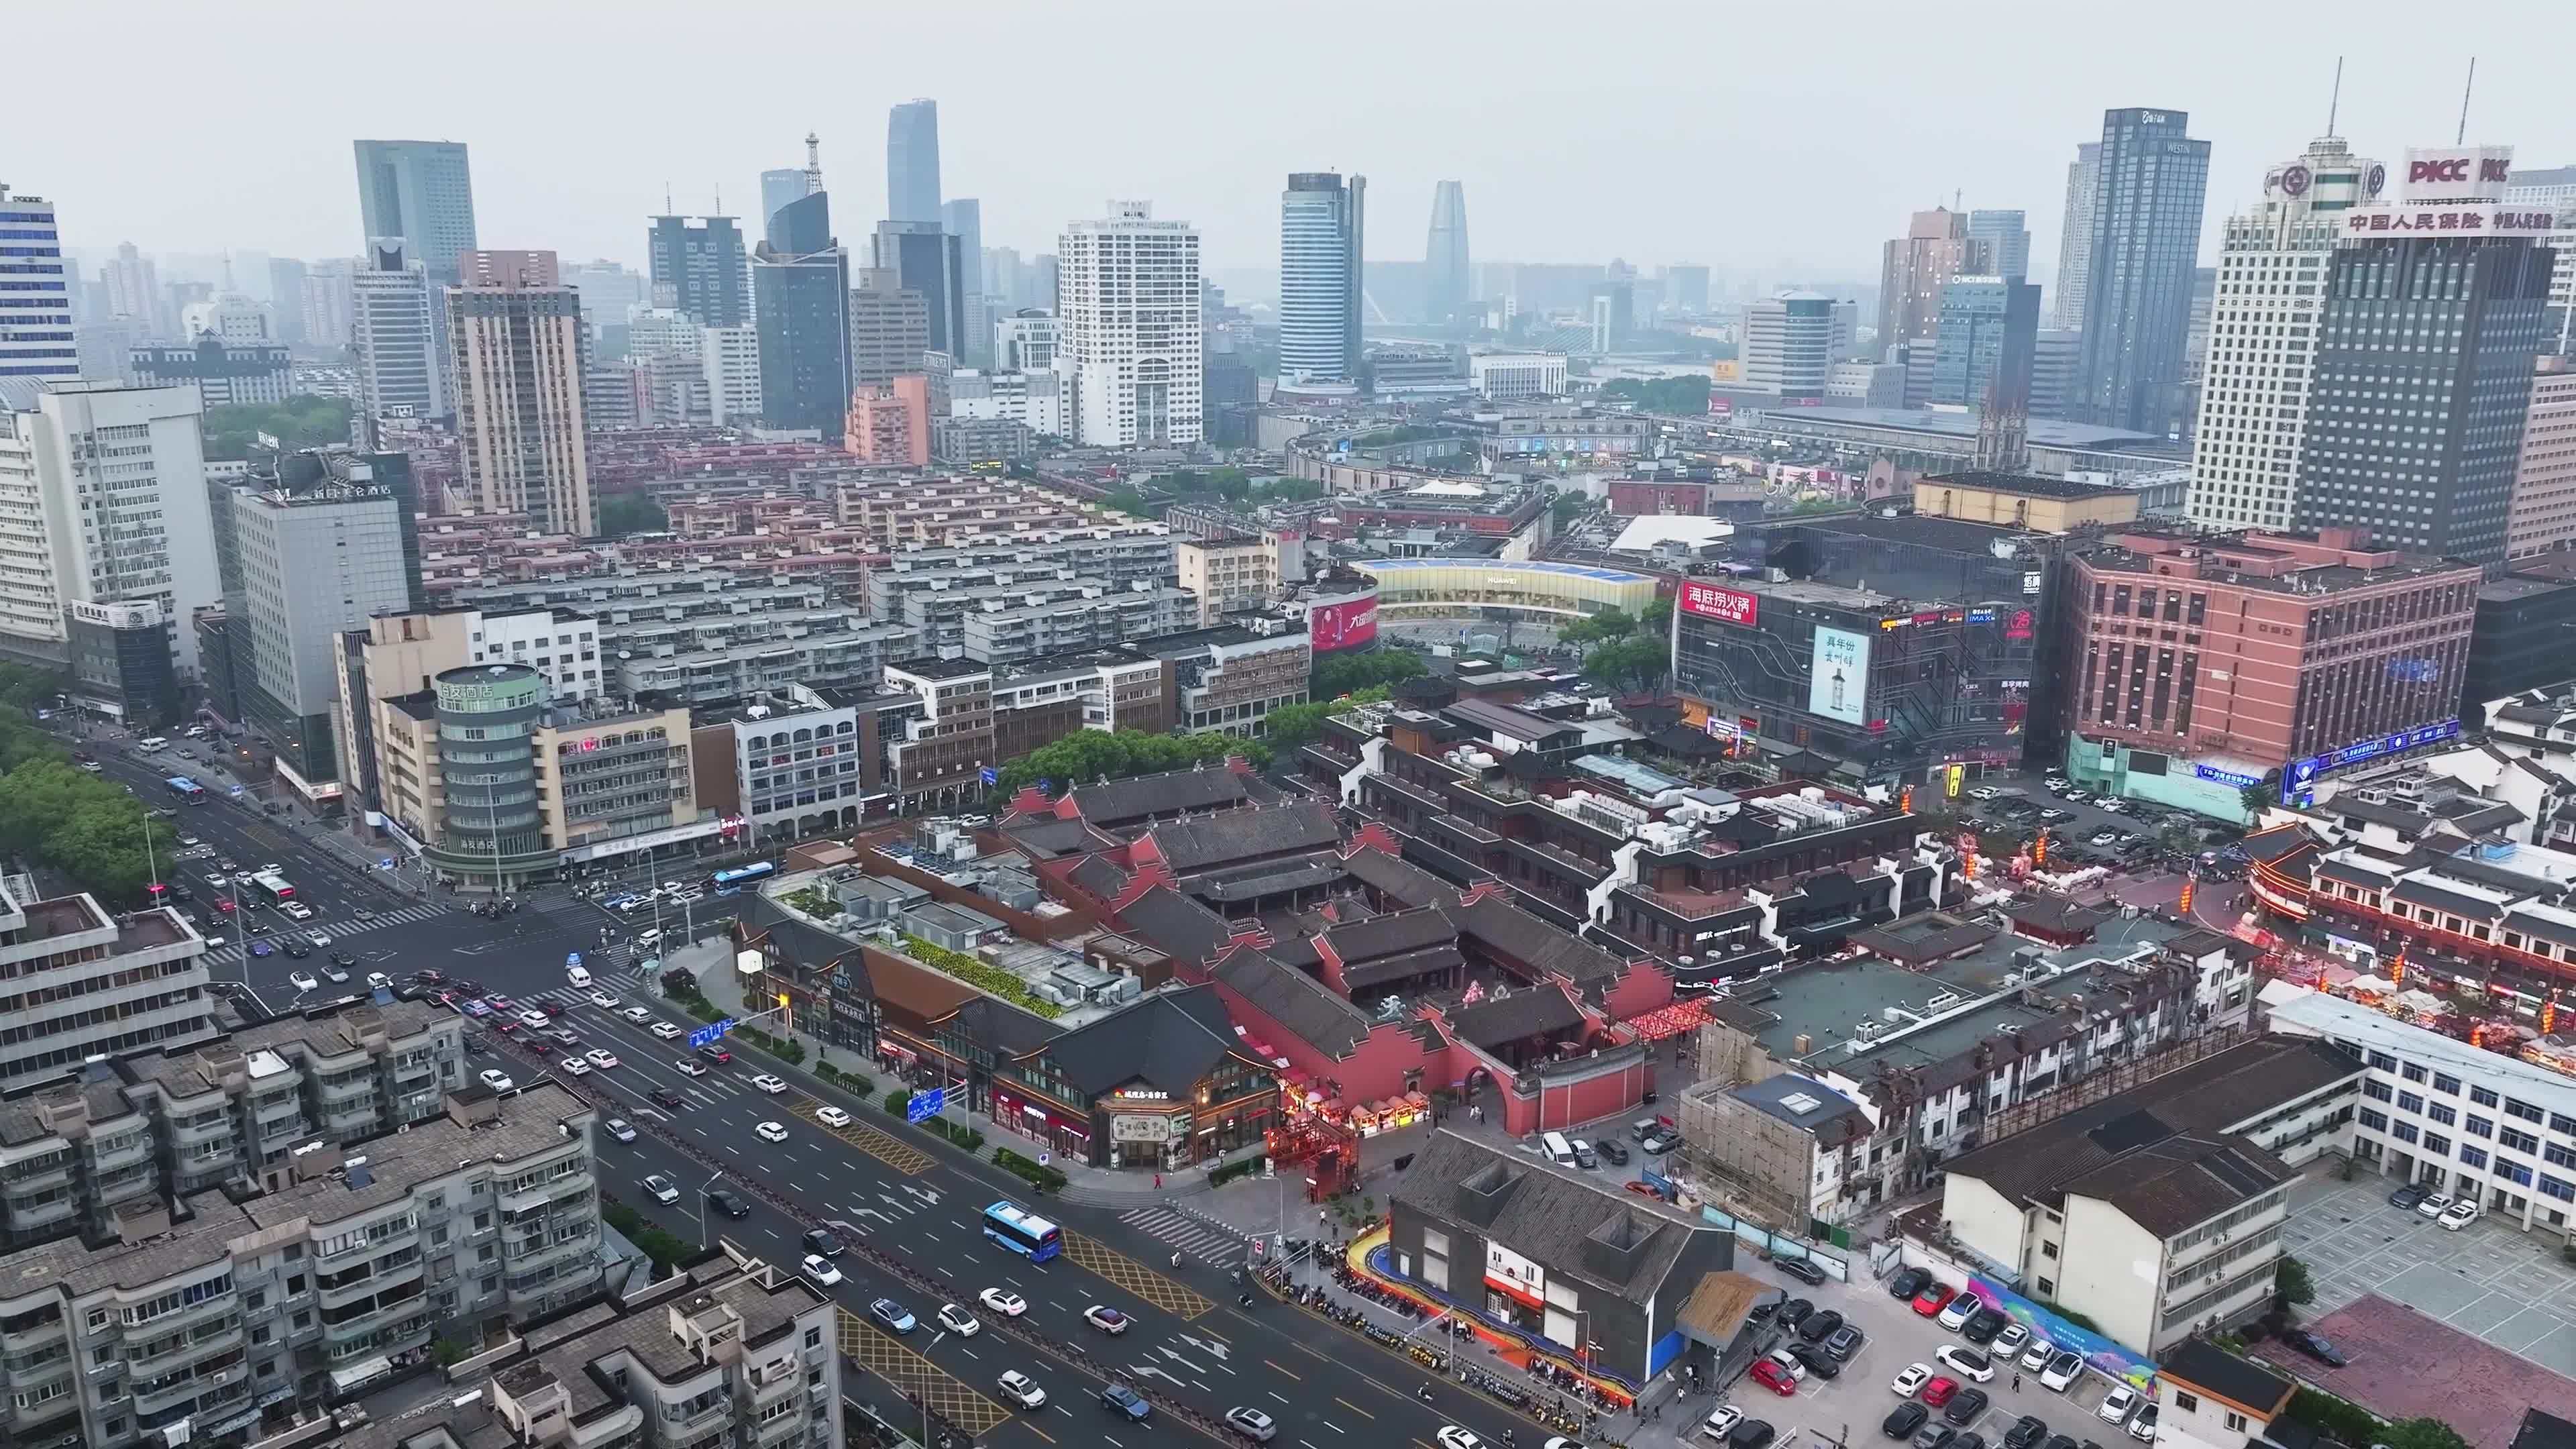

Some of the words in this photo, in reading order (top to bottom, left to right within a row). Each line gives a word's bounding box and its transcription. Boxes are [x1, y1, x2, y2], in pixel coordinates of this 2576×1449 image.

[2167, 140, 2190, 154] WESTIN
[2409, 158, 2469, 182] PICC
[2479, 158, 2510, 182] PICC
[2349, 212, 2483, 231] 中国人民保险
[2493, 212, 2553, 229] 中国人民保险
[1487, 576, 1517, 584] HUAWEI
[1688, 586, 1750, 614] 海底捞火锅
[1827, 636, 1855, 652] 真年份
